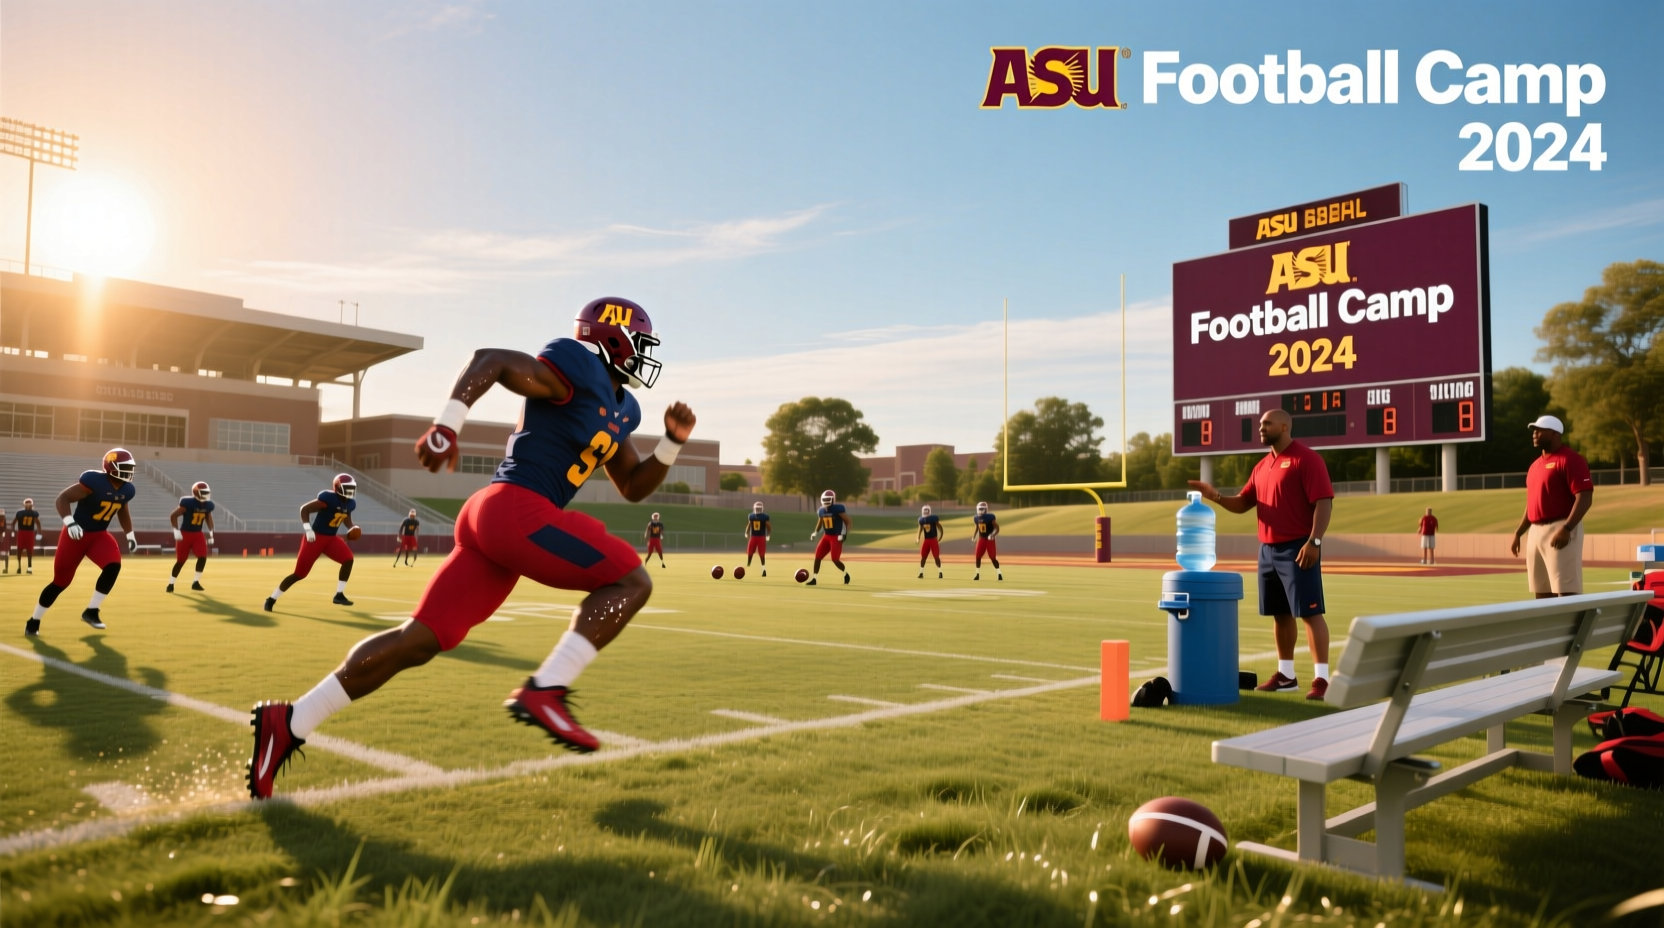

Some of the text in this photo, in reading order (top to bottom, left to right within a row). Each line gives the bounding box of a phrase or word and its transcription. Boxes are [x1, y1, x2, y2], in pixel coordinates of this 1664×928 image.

[1256, 211, 1298, 240] ASU
[1265, 241, 1351, 294] ASU
[1190, 284, 1454, 345] Football Camp
[1268, 335, 1357, 377] 2024
